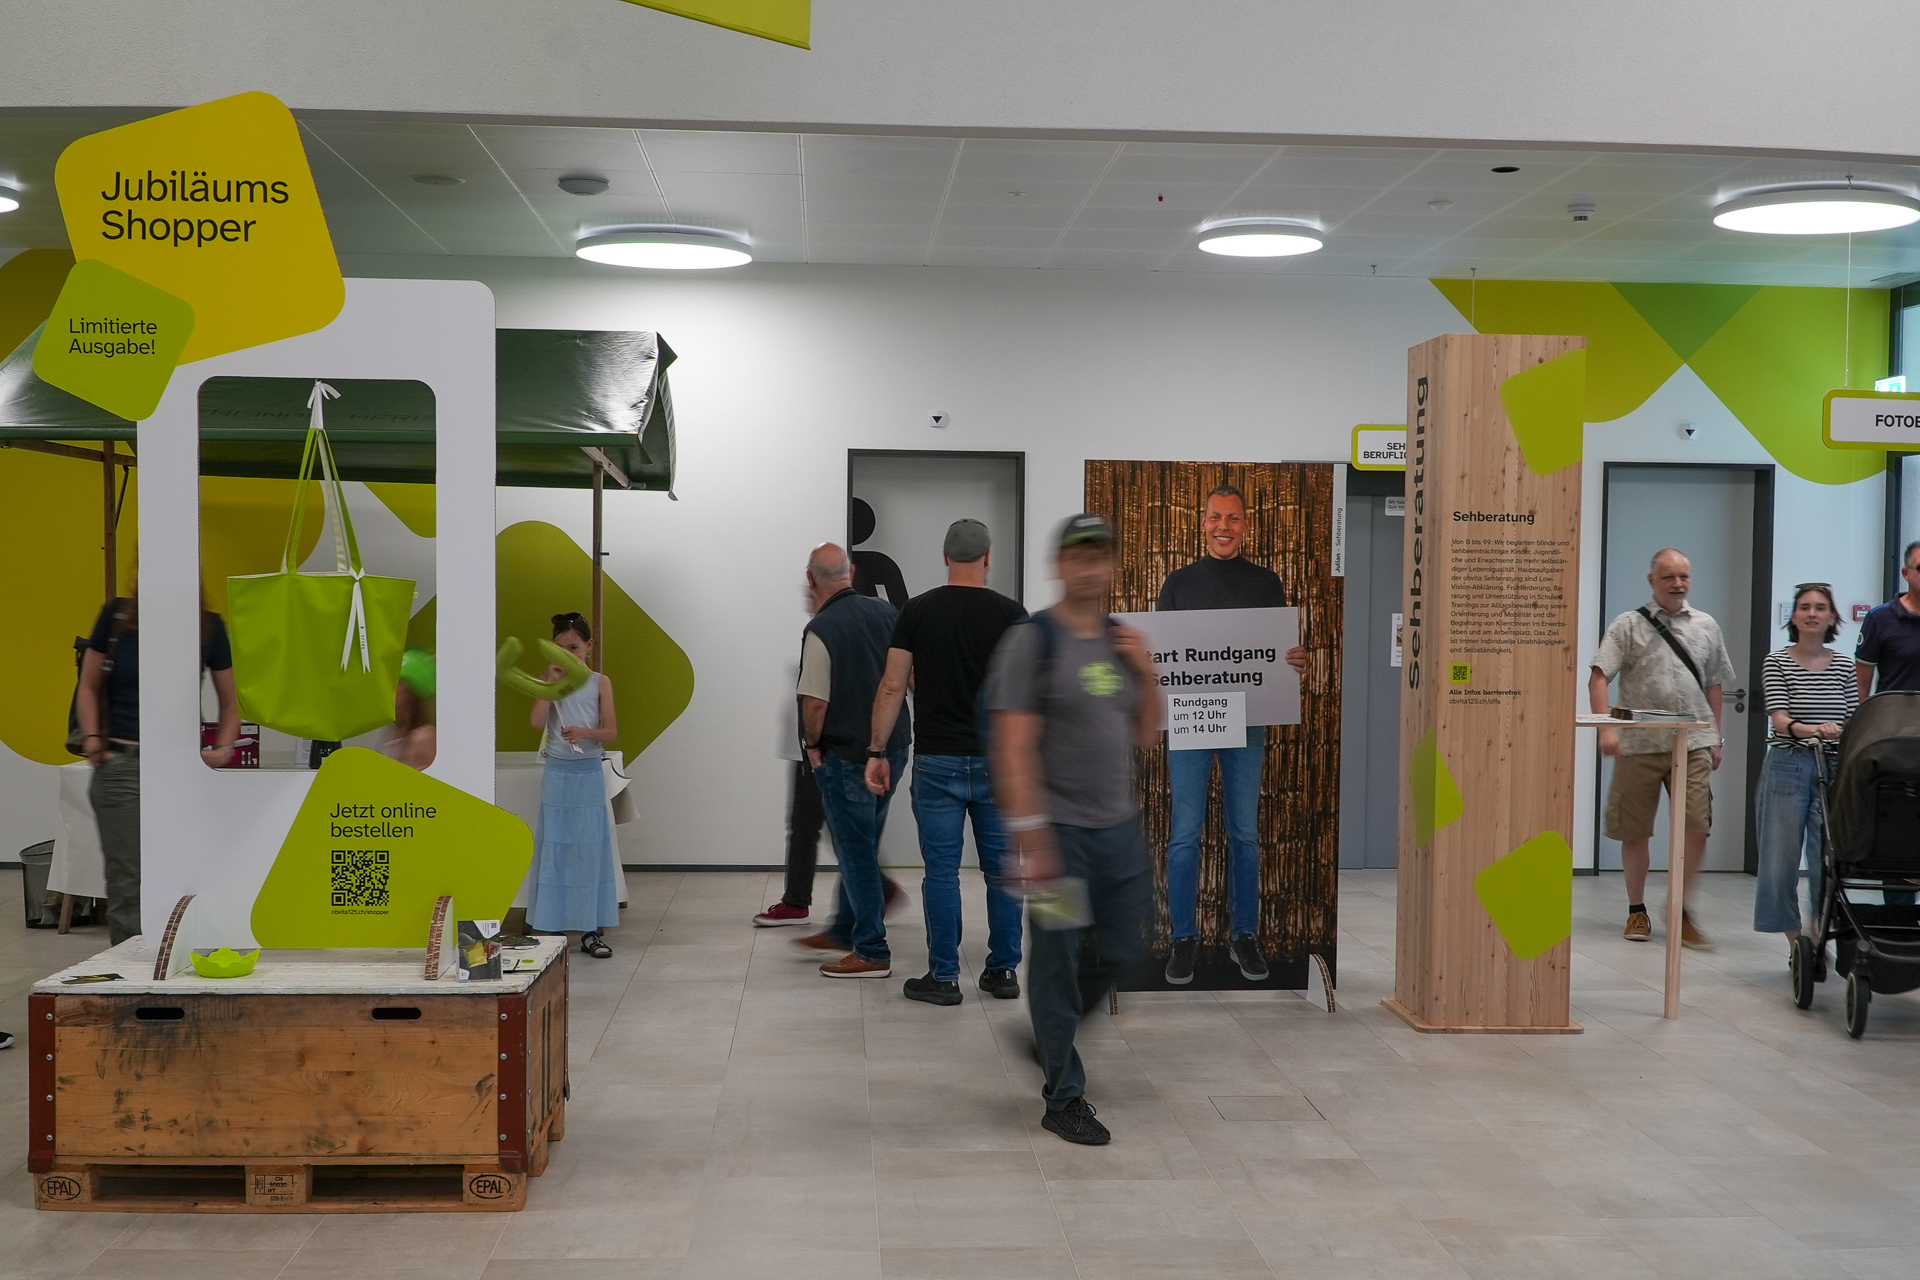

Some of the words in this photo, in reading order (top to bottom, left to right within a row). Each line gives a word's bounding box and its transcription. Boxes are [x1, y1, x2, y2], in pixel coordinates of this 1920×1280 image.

[101, 170, 289, 204] Jubiläums
[101, 209, 257, 248] Shopper
[69, 317, 157, 335] Limitierte
[68, 338, 156, 358] Ausgabe!
[1453, 511, 1535, 525] Sehberatung
[1335, 507, 1343, 547] Sehberatung
[1408, 376, 1429, 691] Sehberatung
[1483, 575, 1523, 583] Sehberatung
[1185, 646, 1276, 664] Rundgang
[1173, 697, 1228, 708] Rundgang
[1173, 712, 1189, 720] um
[1192, 711, 1204, 720] 12
[1207, 710, 1227, 719] Uhr
[1174, 726, 1189, 734] um
[1192, 725, 1205, 733] 14
[1207, 723, 1227, 733] Uhr
[330, 803, 375, 819] Jetzt
[380, 802, 437, 819] online
[331, 821, 414, 838] bestellen
[46, 1180, 75, 1196] EPAL
[475, 1180, 504, 1195] EPAL
